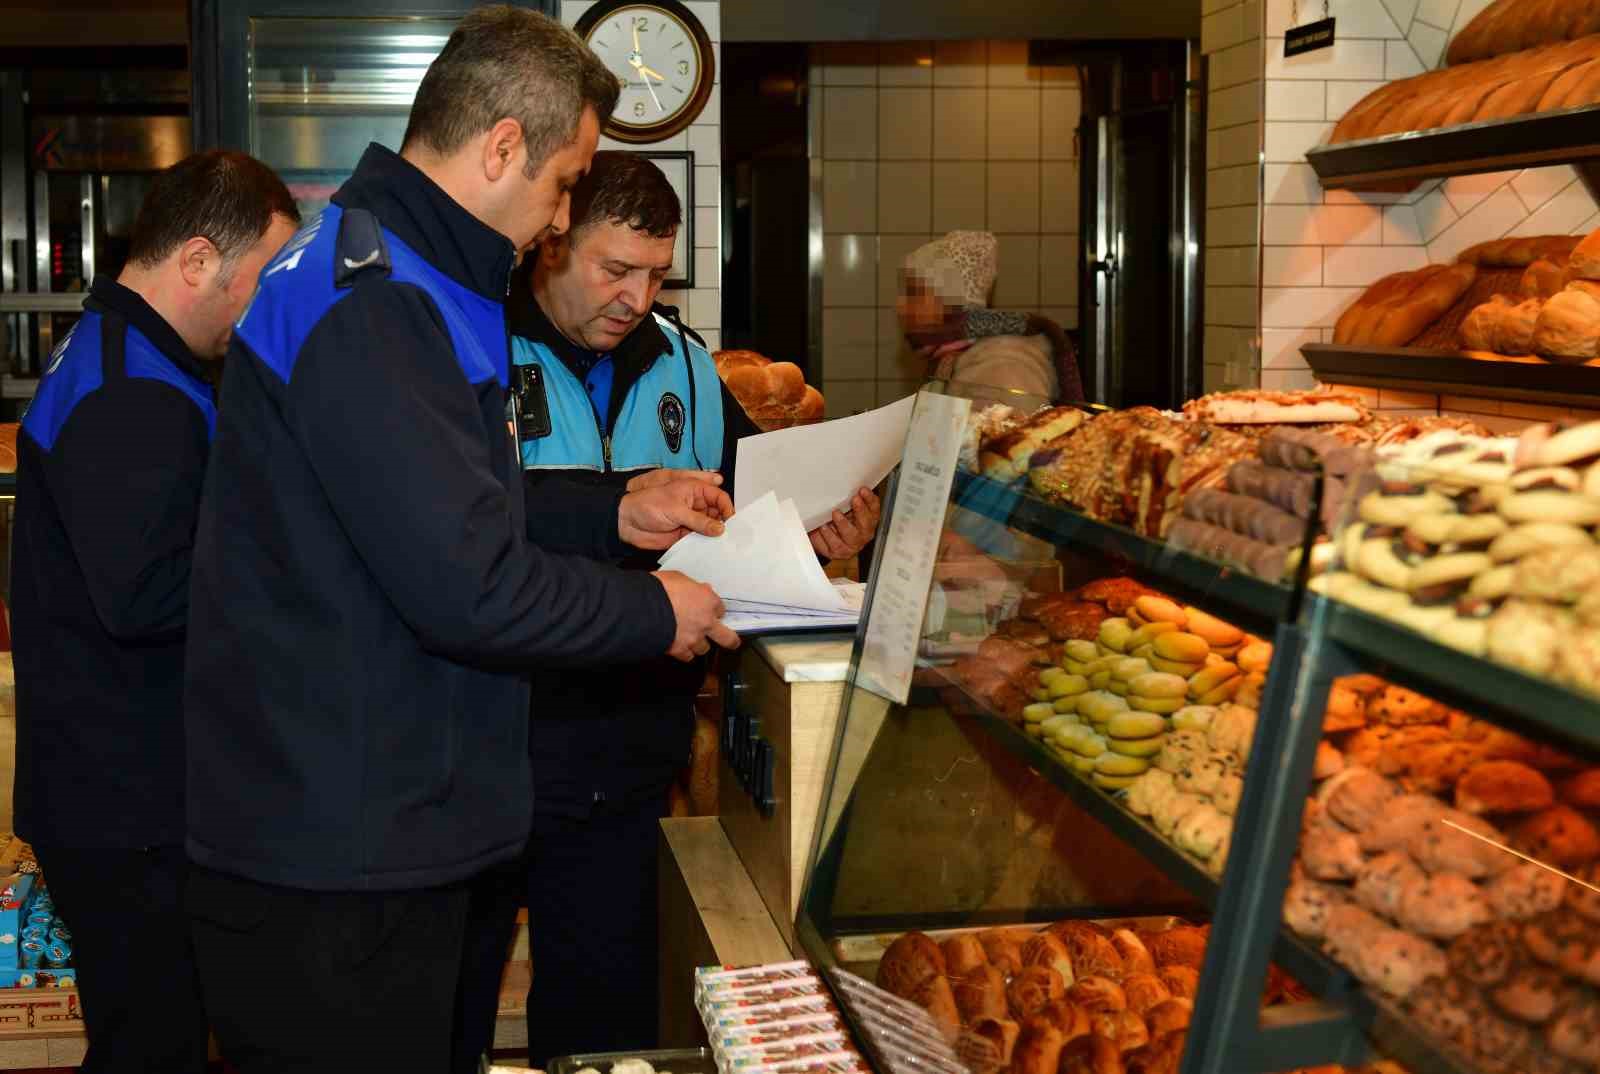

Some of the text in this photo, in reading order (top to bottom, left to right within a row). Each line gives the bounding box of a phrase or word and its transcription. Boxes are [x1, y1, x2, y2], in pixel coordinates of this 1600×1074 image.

[632, 17, 648, 32] 12
[678, 60, 688, 76] 3
[634, 102, 645, 117] 6
